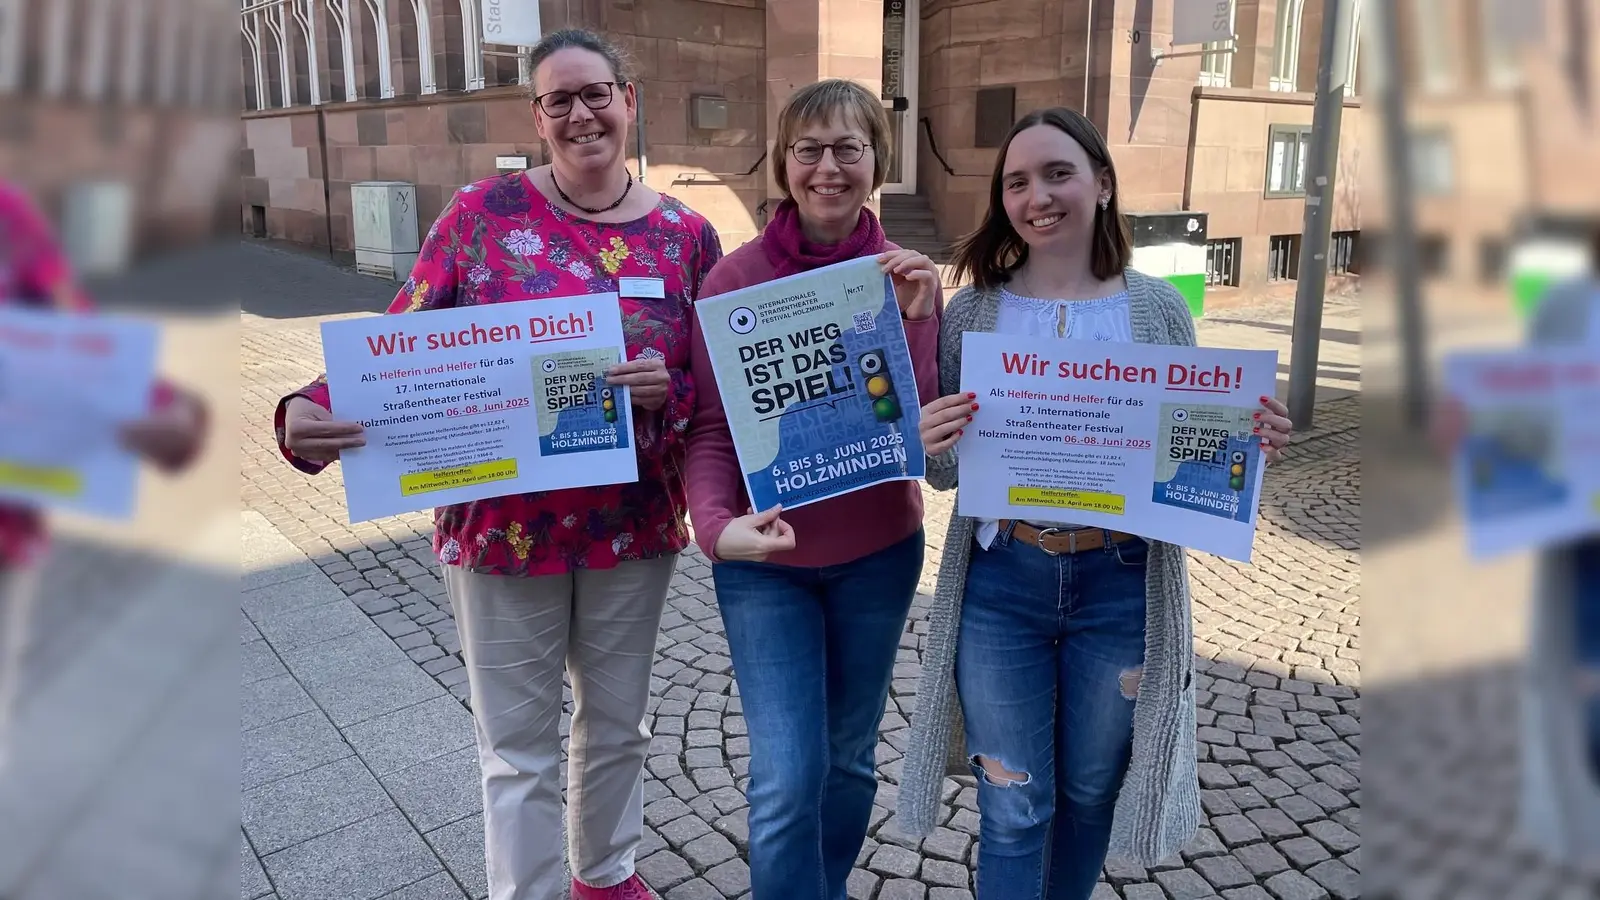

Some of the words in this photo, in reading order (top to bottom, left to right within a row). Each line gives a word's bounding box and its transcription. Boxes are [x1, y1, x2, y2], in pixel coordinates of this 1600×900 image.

[1127, 30, 1140, 44] 30
[758, 290, 816, 310] INTERNATIONALES
[847, 285, 864, 296] Nr.17
[762, 312, 792, 324] FESTIVAL
[792, 302, 834, 316] HOLZMINDEN
[366, 332, 418, 356] Wir
[427, 322, 521, 350] suchen
[529, 311, 594, 338] Dich!
[738, 338, 784, 363] DER
[788, 322, 842, 350] WEG
[361, 372, 377, 382] Als
[380, 368, 421, 380] Helferin
[424, 364, 444, 375] und
[446, 360, 478, 372] Helfer
[479, 358, 494, 368] für
[496, 356, 514, 366] das
[744, 359, 784, 386] IST
[792, 344, 847, 374] DAS
[1002, 352, 1050, 377] Wir
[1058, 358, 1156, 384] suchen
[1167, 364, 1242, 389] Dich!
[395, 384, 411, 394] 17.
[414, 375, 486, 392] Internationale
[545, 375, 566, 386] DER
[569, 372, 594, 382] WEG
[546, 386, 566, 396] IST
[570, 382, 596, 394] DAS
[383, 394, 460, 412] Straßentheater
[464, 388, 502, 400] Festival
[752, 366, 856, 414] SPIEL!
[990, 388, 1005, 398] Als
[1007, 390, 1048, 401] Helferin
[1050, 392, 1070, 402] und
[1072, 392, 1105, 404] Helfer
[1107, 396, 1122, 406] für
[1125, 397, 1144, 408] das
[422, 410, 444, 420] vom
[446, 404, 481, 416] 06.-08.
[484, 400, 504, 412] Juni
[506, 397, 529, 408] 2025
[547, 392, 598, 410] SPIEL!
[1020, 406, 1035, 416] 17.
[1038, 406, 1110, 419] Internationale
[582, 429, 598, 437] JUNI
[600, 427, 616, 435] 2025
[1006, 418, 1082, 432] Straßentheater
[1084, 424, 1124, 434] Festival
[1172, 426, 1197, 436] DER
[1200, 428, 1229, 438] WEG
[552, 434, 618, 448] HOLZMINDEN
[978, 430, 1038, 442] Holzminden
[1040, 434, 1062, 443] vom
[1064, 434, 1100, 446] 06.-08.
[1102, 437, 1123, 447] Juni
[1126, 438, 1151, 450] 2025
[1170, 436, 1194, 446] IST
[1198, 439, 1228, 450] DAS
[772, 466, 786, 476] 6.
[788, 456, 812, 472] BIS
[816, 453, 829, 464] 8.
[834, 440, 866, 460] JUNI
[871, 432, 904, 450] 2025
[1170, 446, 1226, 466] SPIEL!
[776, 447, 908, 494] HOLZMINDEN
[1165, 490, 1238, 513] HOLZMINDEN
[1190, 486, 1198, 494] 8.
[1200, 490, 1218, 498] JUNI
[1221, 493, 1240, 503] 2025
